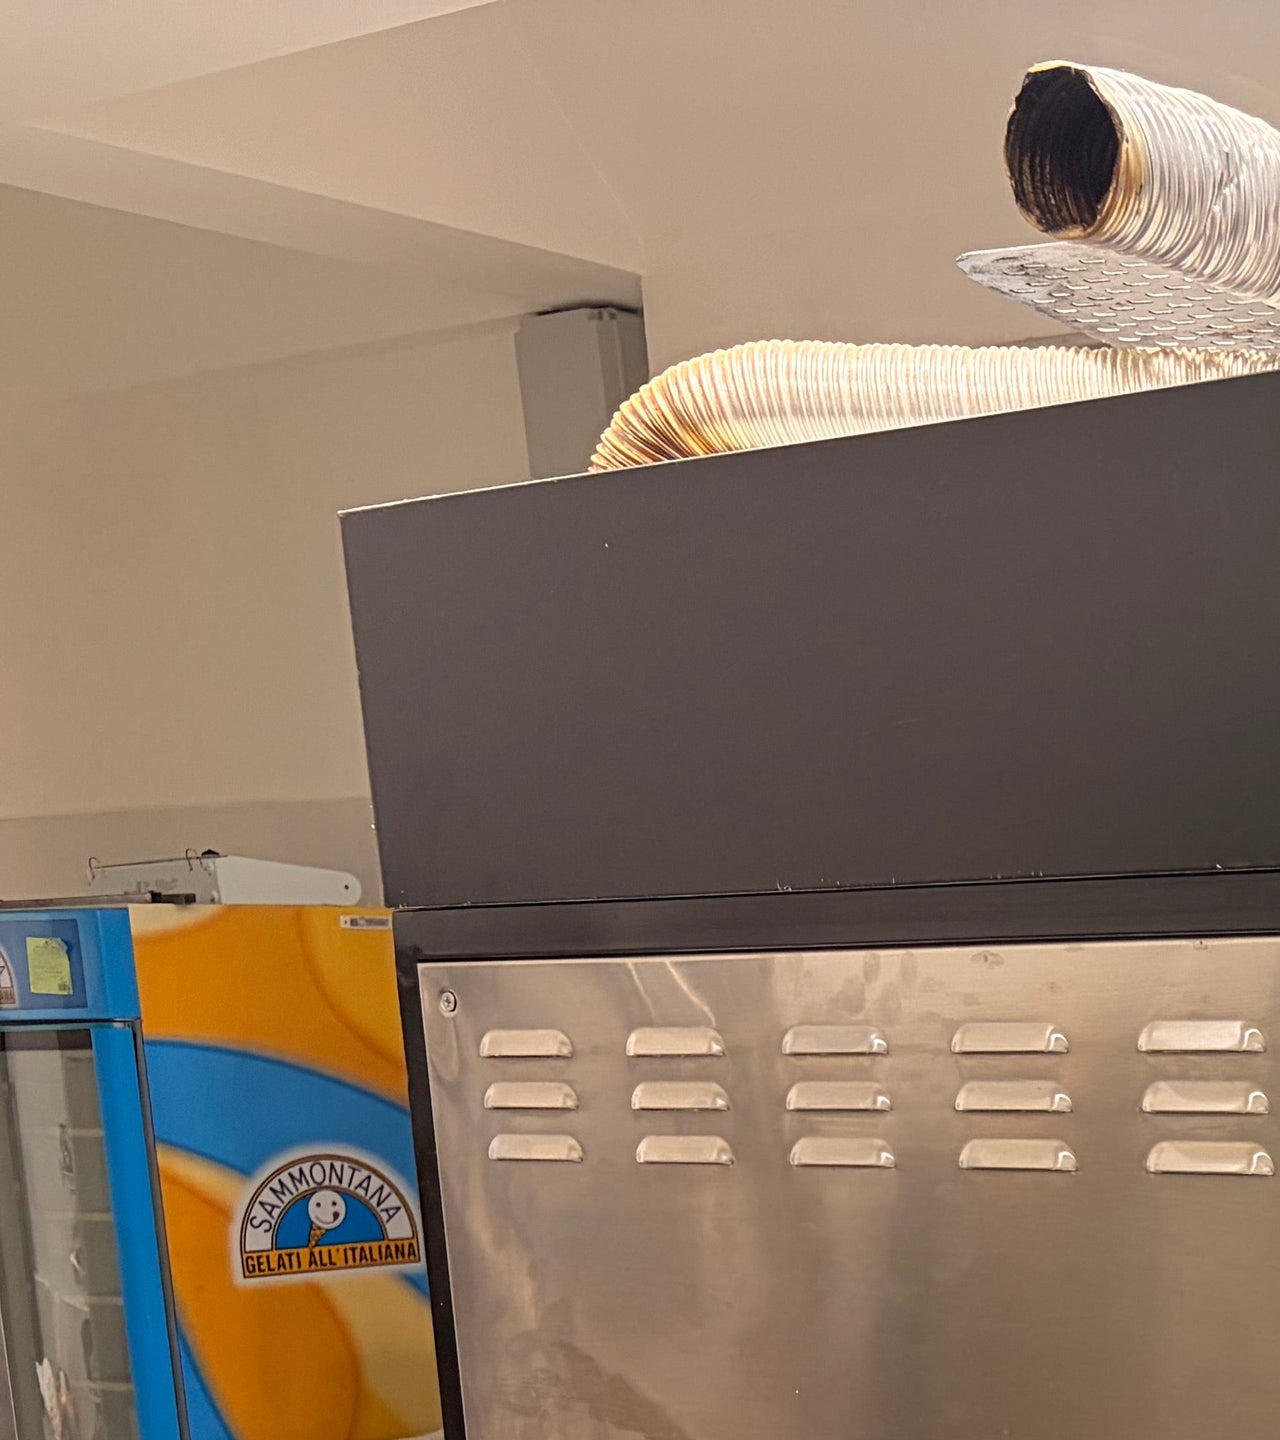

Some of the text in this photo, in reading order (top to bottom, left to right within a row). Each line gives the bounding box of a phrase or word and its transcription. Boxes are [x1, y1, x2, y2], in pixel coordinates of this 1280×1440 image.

[250, 1161, 402, 1233] SAMMONTANA
[245, 1242, 418, 1274] GELATI ALL'ITALIANA
